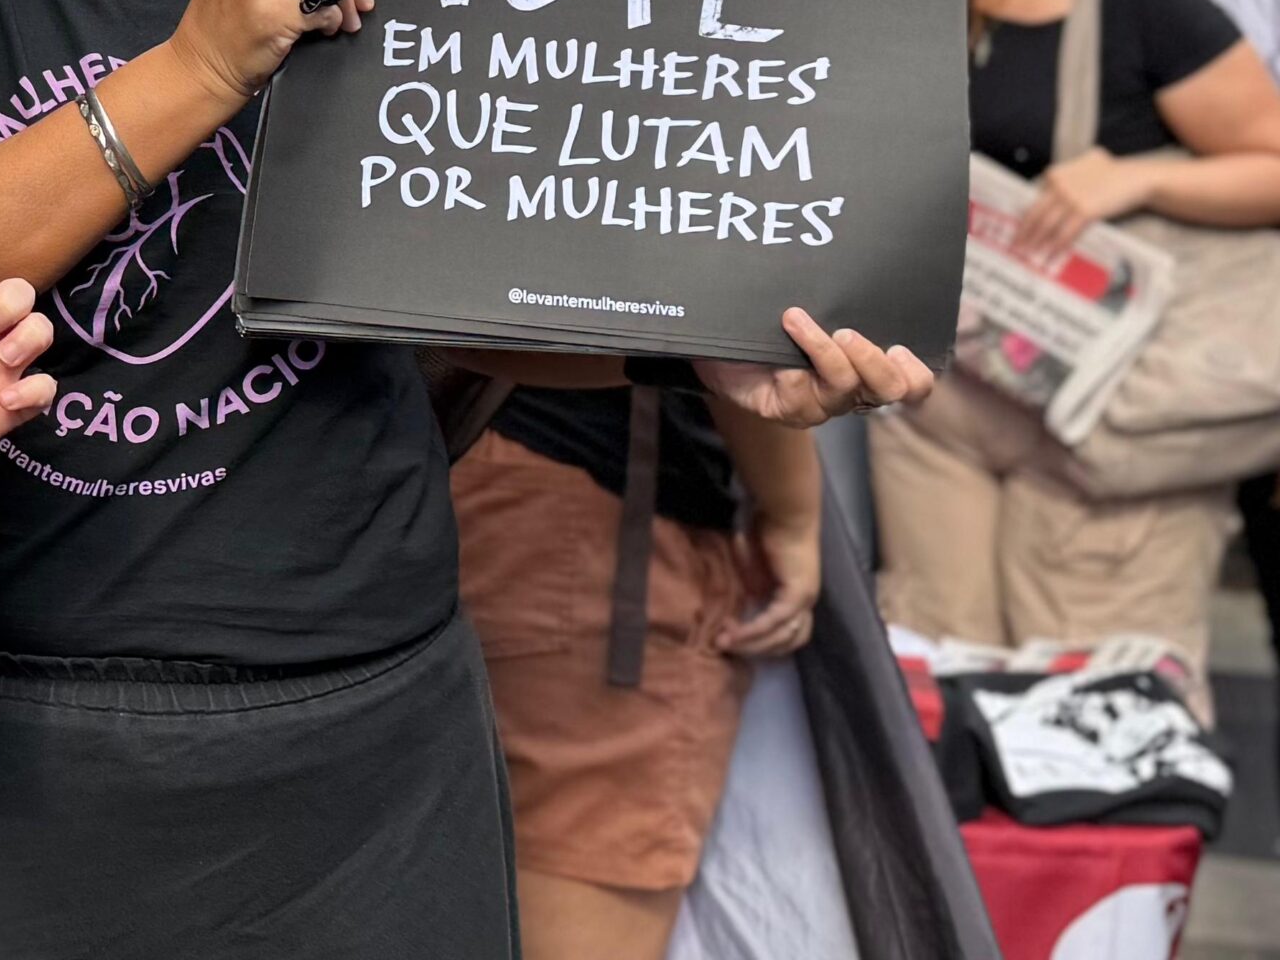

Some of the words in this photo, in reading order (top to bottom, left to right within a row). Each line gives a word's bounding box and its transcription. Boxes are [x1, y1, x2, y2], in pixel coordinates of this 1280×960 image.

[382, 19, 462, 75] EM
[488, 32, 831, 106] MULHERES
[378, 81, 539, 156] QUE
[558, 103, 813, 182] LUTAM
[360, 155, 487, 211] POR
[506, 174, 846, 247] MULHERES
[508, 287, 686, 318] @levantemulheresvivas
[43, 390, 160, 444] ÇÃO
